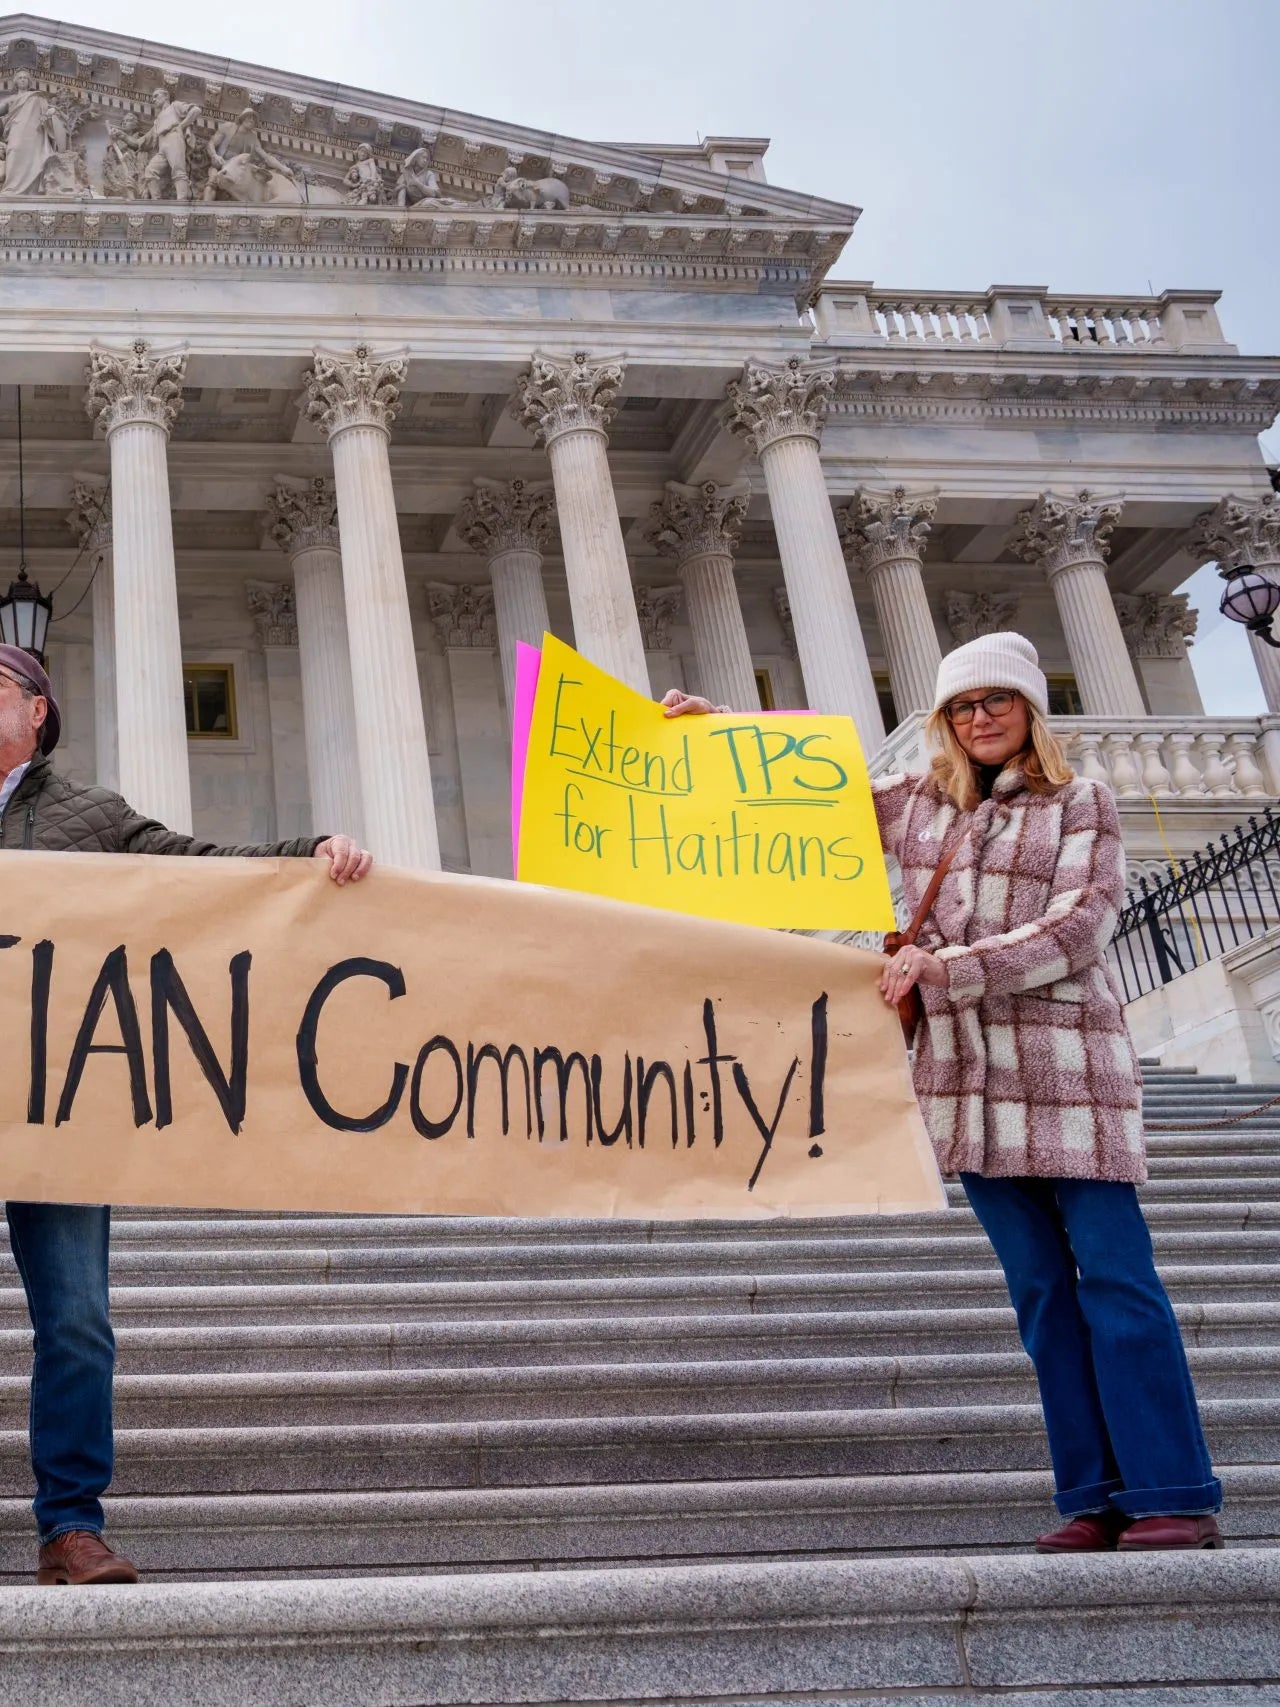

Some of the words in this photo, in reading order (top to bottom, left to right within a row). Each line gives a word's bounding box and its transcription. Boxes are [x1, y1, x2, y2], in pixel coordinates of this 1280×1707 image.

[550, 673, 694, 793] Extend
[709, 724, 849, 796] TPS
[554, 783, 613, 858] for
[628, 795, 864, 881] Haitians
[296, 957, 829, 1191] Community!
